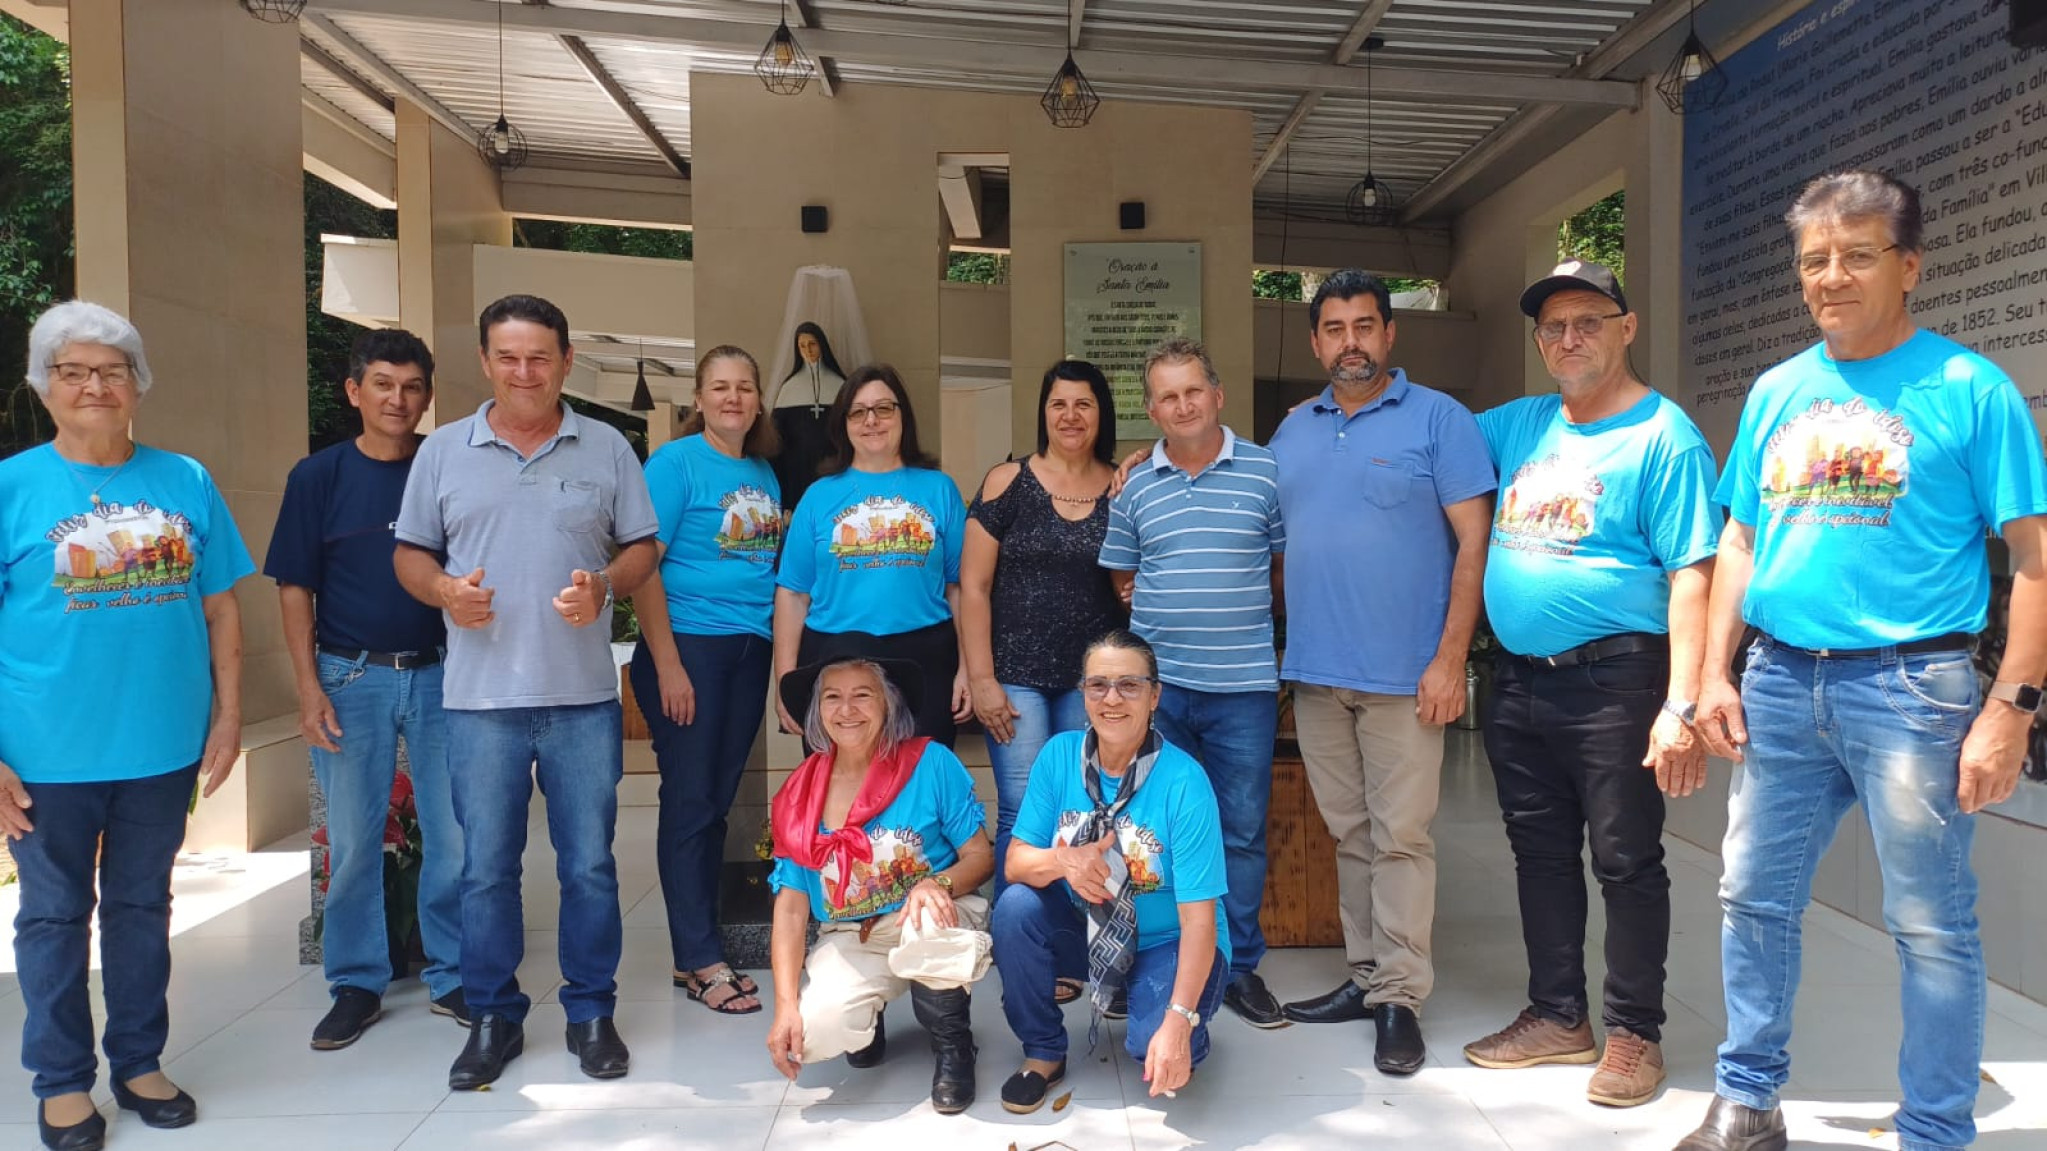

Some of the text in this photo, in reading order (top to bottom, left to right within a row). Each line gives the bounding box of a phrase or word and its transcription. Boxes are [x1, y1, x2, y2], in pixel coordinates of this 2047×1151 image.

[1862, 41, 1870, 54] e
[1926, 9, 1977, 54] gostava
[1809, 144, 1828, 165] que
[1830, 128, 1857, 154] fazia
[1859, 118, 1878, 138] aos
[1880, 96, 1925, 132] pobres,
[1927, 75, 1968, 106] Emília
[1972, 56, 2007, 85] ouviu
[1850, 77, 1906, 116] Apreciava
[1908, 57, 1944, 86] muito
[1947, 52, 1956, 67] a
[1912, 117, 1944, 142] como
[1948, 107, 1966, 127] um
[1970, 84, 2013, 116] dardo
[2016, 81, 2026, 97] a
[1916, 140, 1960, 175] passou
[1963, 136, 1971, 150] a
[1975, 123, 1999, 146] ser
[2002, 119, 2012, 134] a
[1742, 239, 1768, 262] escola
[1928, 172, 1955, 193] com
[1958, 156, 1989, 181] três
[1941, 181, 1997, 218] Família"
[2000, 179, 2021, 198] em
[1742, 293, 1760, 310] com
[1956, 223, 1978, 244] Ela
[1982, 206, 2037, 237] fundou,
[1748, 306, 1792, 331] dedicadas
[1793, 305, 1800, 319] a
[1925, 251, 1980, 282] situação
[1985, 232, 2047, 265] delicada
[1740, 365, 1755, 379] sua
[1941, 318, 1958, 337] de
[1962, 307, 2001, 333] 1852.
[2005, 303, 2034, 323] Seu
[1757, 334, 1772, 352] Diz
[1773, 335, 1780, 348] a
[1782, 322, 1822, 346] tradição
[1910, 289, 1962, 316] doentes
